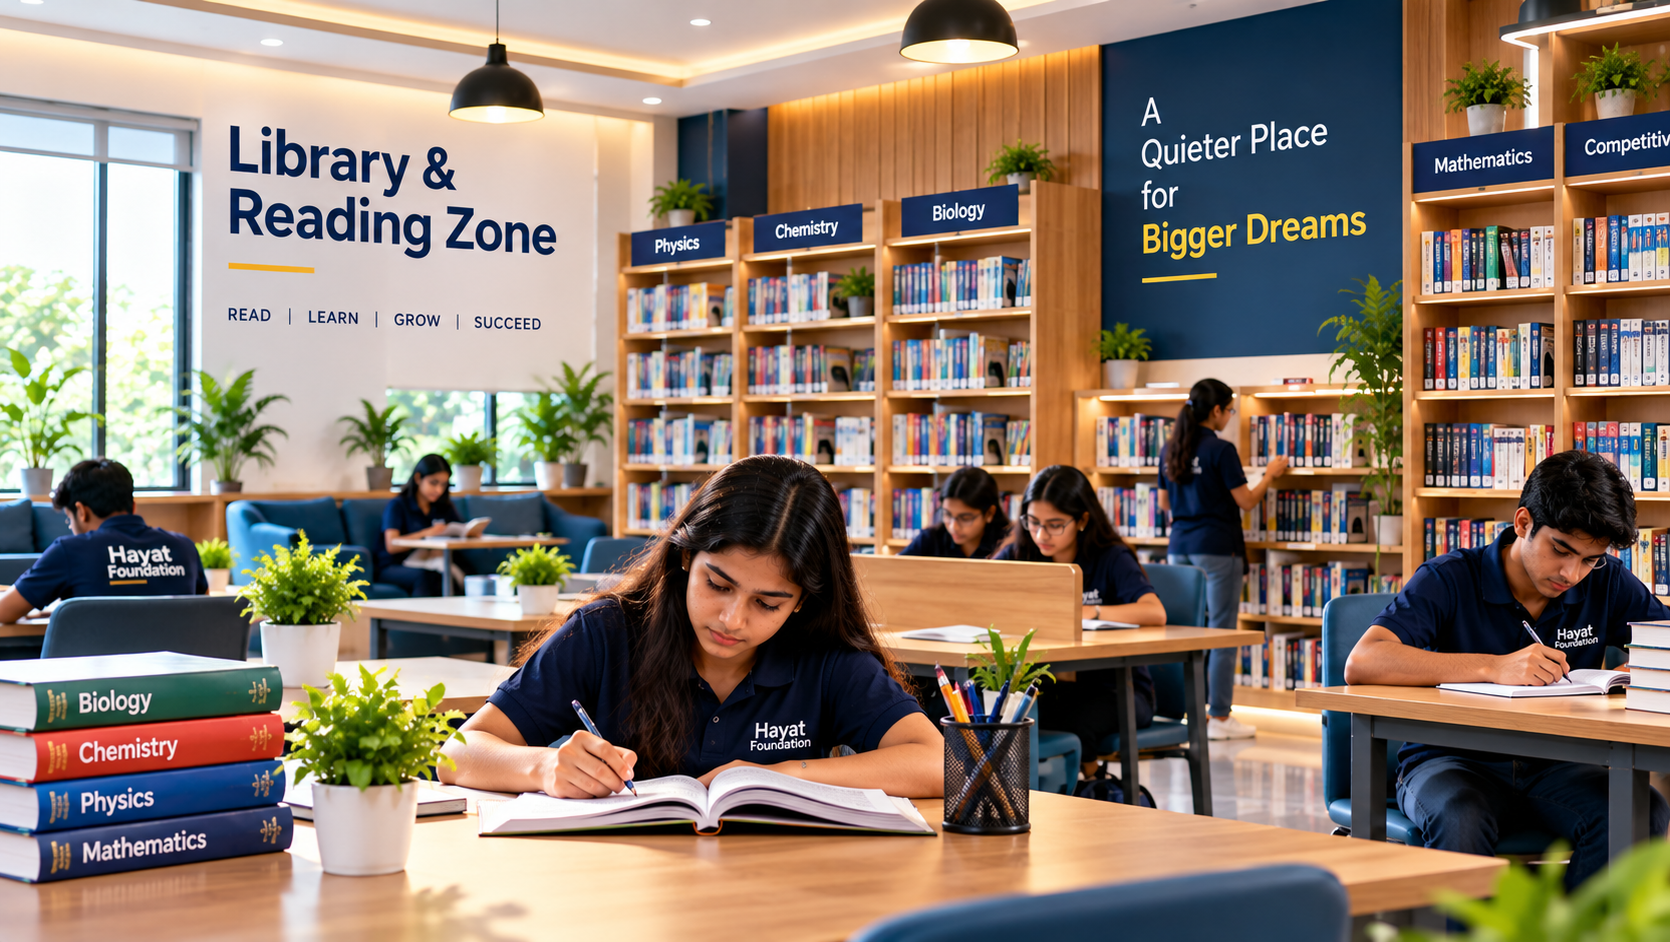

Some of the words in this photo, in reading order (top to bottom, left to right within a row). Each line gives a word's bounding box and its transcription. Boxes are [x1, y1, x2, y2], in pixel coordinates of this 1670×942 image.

[1141, 97, 1161, 126] A
[1141, 134, 1241, 169] Quieter
[1252, 121, 1327, 154] Place
[1584, 130, 1670, 156] Competitiv
[230, 126, 410, 197] Library
[423, 147, 456, 190] &
[1435, 149, 1532, 173] Mathematics
[1141, 180, 1178, 209] for
[230, 188, 431, 258] Reading
[446, 206, 556, 255] Zone
[932, 201, 985, 223] Biology
[775, 218, 838, 240] Chemistry
[1142, 221, 1237, 260] Bigger
[1247, 212, 1366, 244] Dreams
[655, 236, 700, 256] Physics
[228, 307, 272, 322] READ
[308, 311, 359, 325] LEARN
[393, 313, 441, 327] GROW
[474, 316, 542, 330] SUCCEED
[107, 545, 173, 567] Hayat
[107, 562, 186, 579] Foundation
[1557, 624, 1593, 642] Hayat
[79, 689, 152, 715] Biology
[755, 720, 806, 741] Hayat
[79, 737, 178, 763] Chemistry
[750, 738, 811, 751] Foundation
[80, 787, 154, 816] Physics
[82, 830, 207, 864] Mathematics
